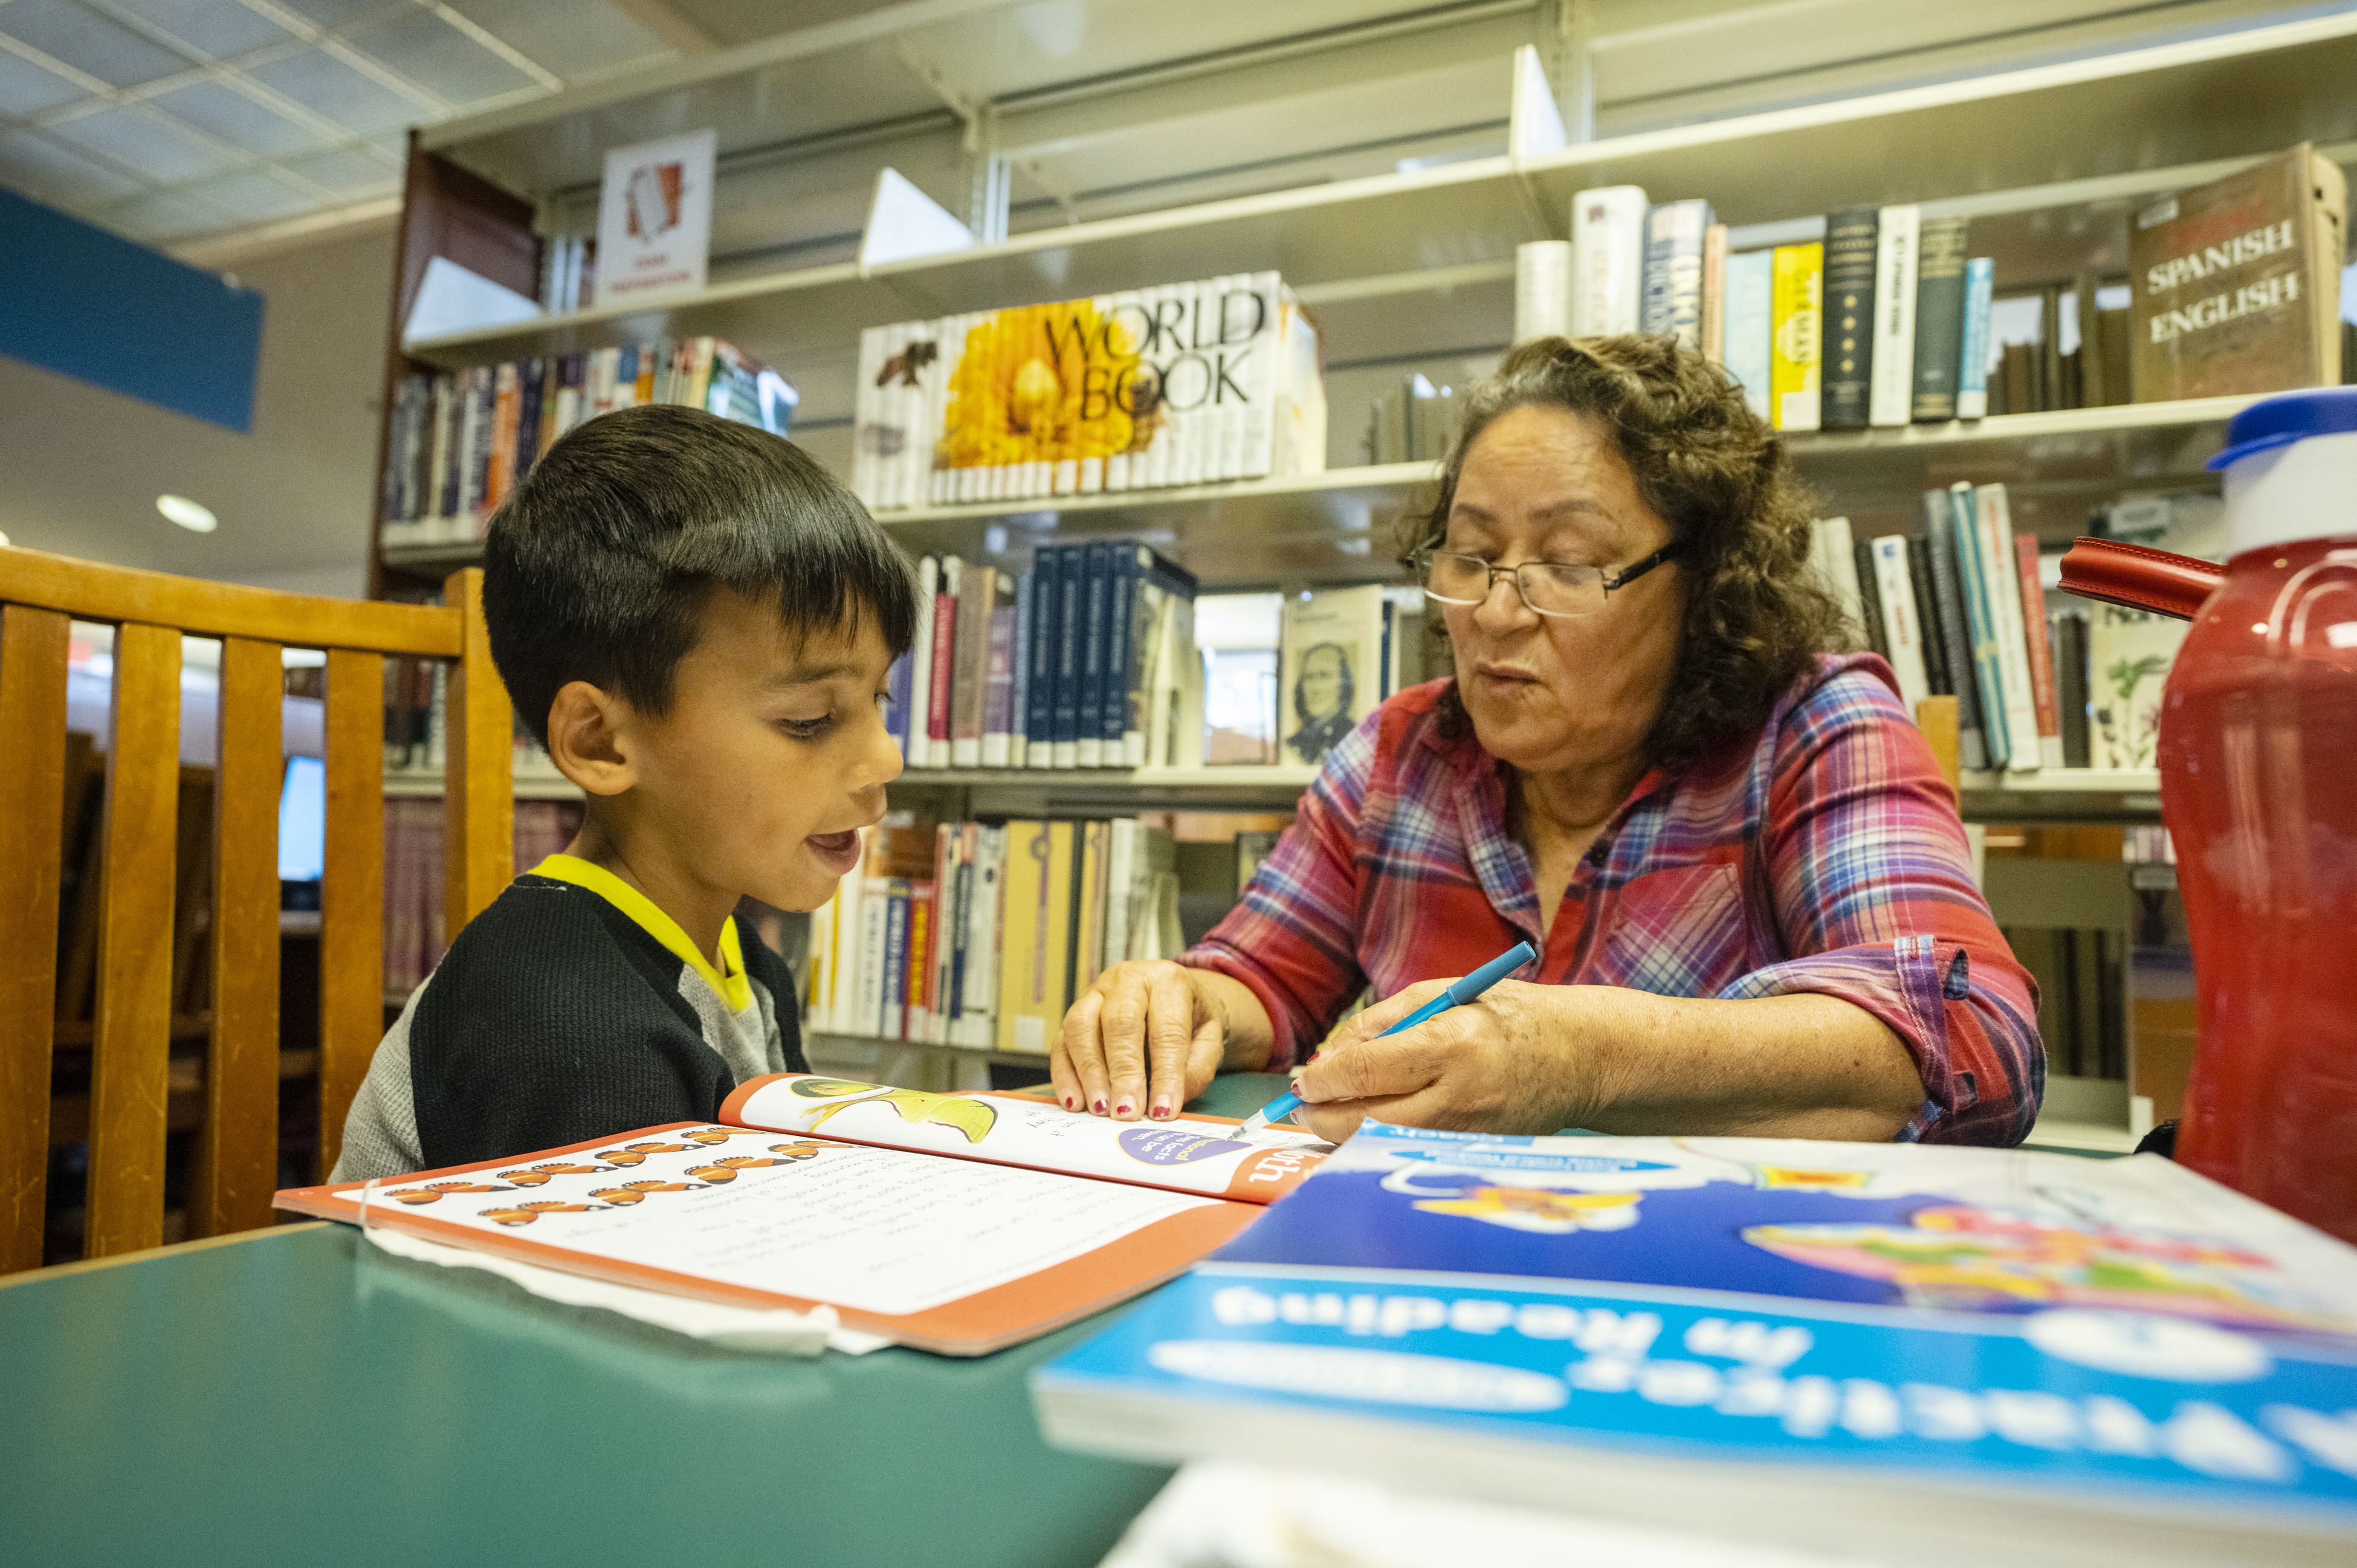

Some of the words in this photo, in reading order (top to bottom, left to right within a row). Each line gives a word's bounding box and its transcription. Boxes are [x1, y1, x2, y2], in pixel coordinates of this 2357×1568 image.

[2147, 218, 2295, 295] SPANISH
[1044, 289, 1264, 369] WORLD
[1793, 268, 1814, 367] GERMAN
[2150, 271, 2298, 344] ENGLISH
[1081, 347, 1252, 421] BOOK
[1141, 1138, 1163, 1152] be
[1154, 1140, 1184, 1161] facts
[1211, 1285, 1661, 1354] Reading
